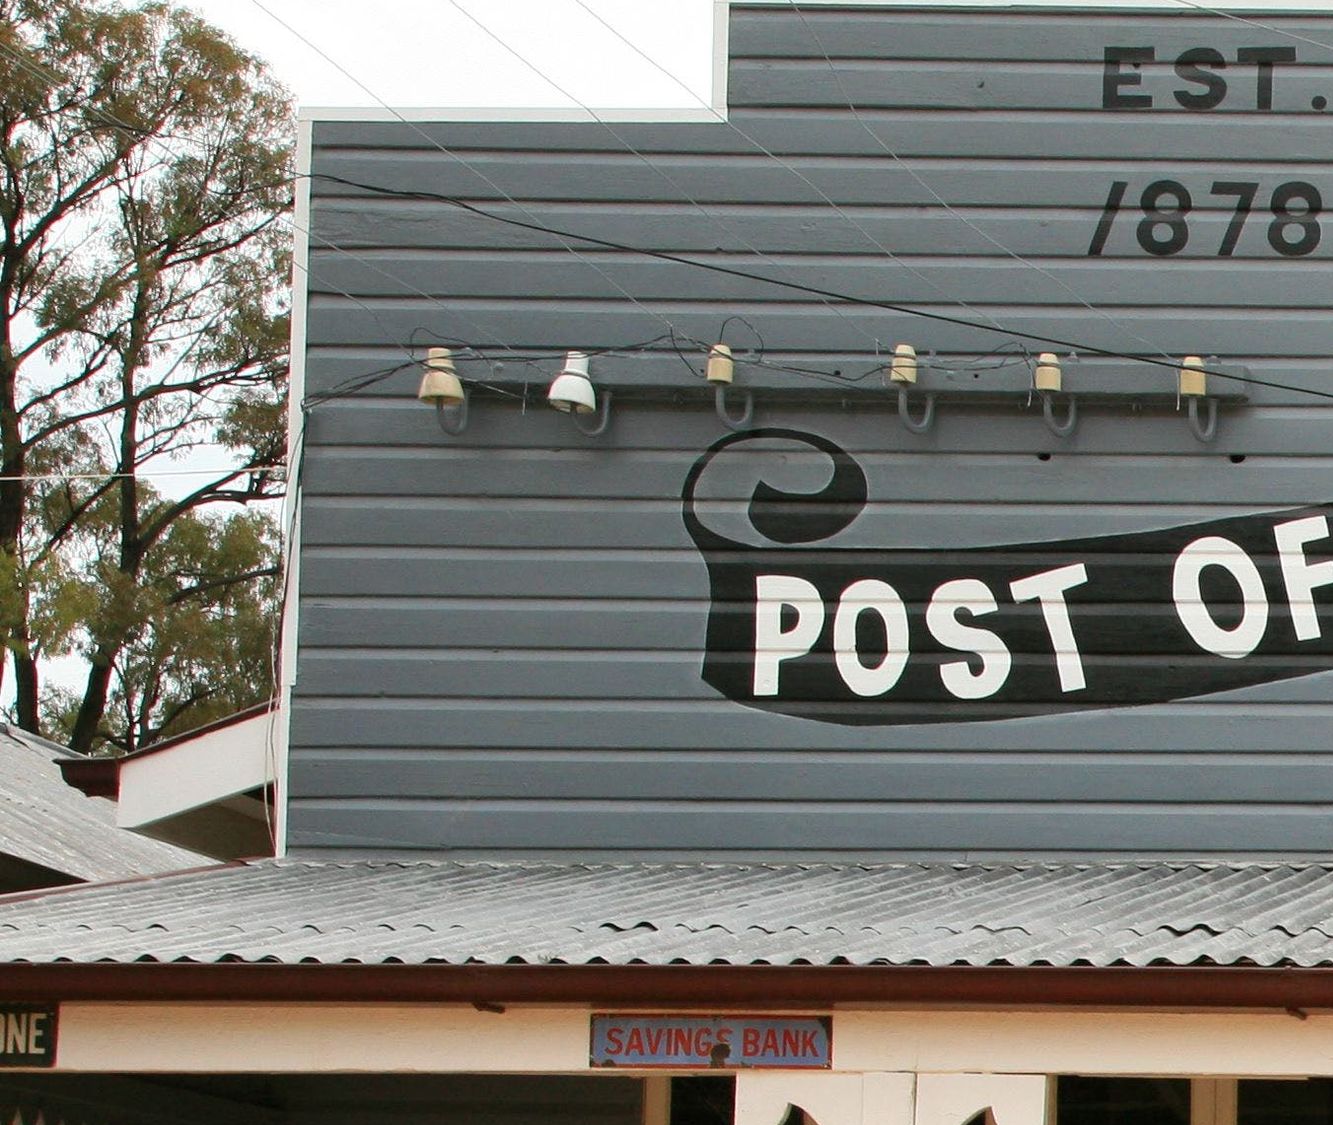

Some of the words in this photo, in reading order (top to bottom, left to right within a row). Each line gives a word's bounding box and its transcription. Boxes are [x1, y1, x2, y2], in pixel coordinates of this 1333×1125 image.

[1102, 46, 1328, 110] EST.
[1087, 180, 1323, 257] 1878
[753, 562, 1090, 699] POST
[0, 1013, 48, 1054] NE
[742, 1028, 820, 1058] BANK
